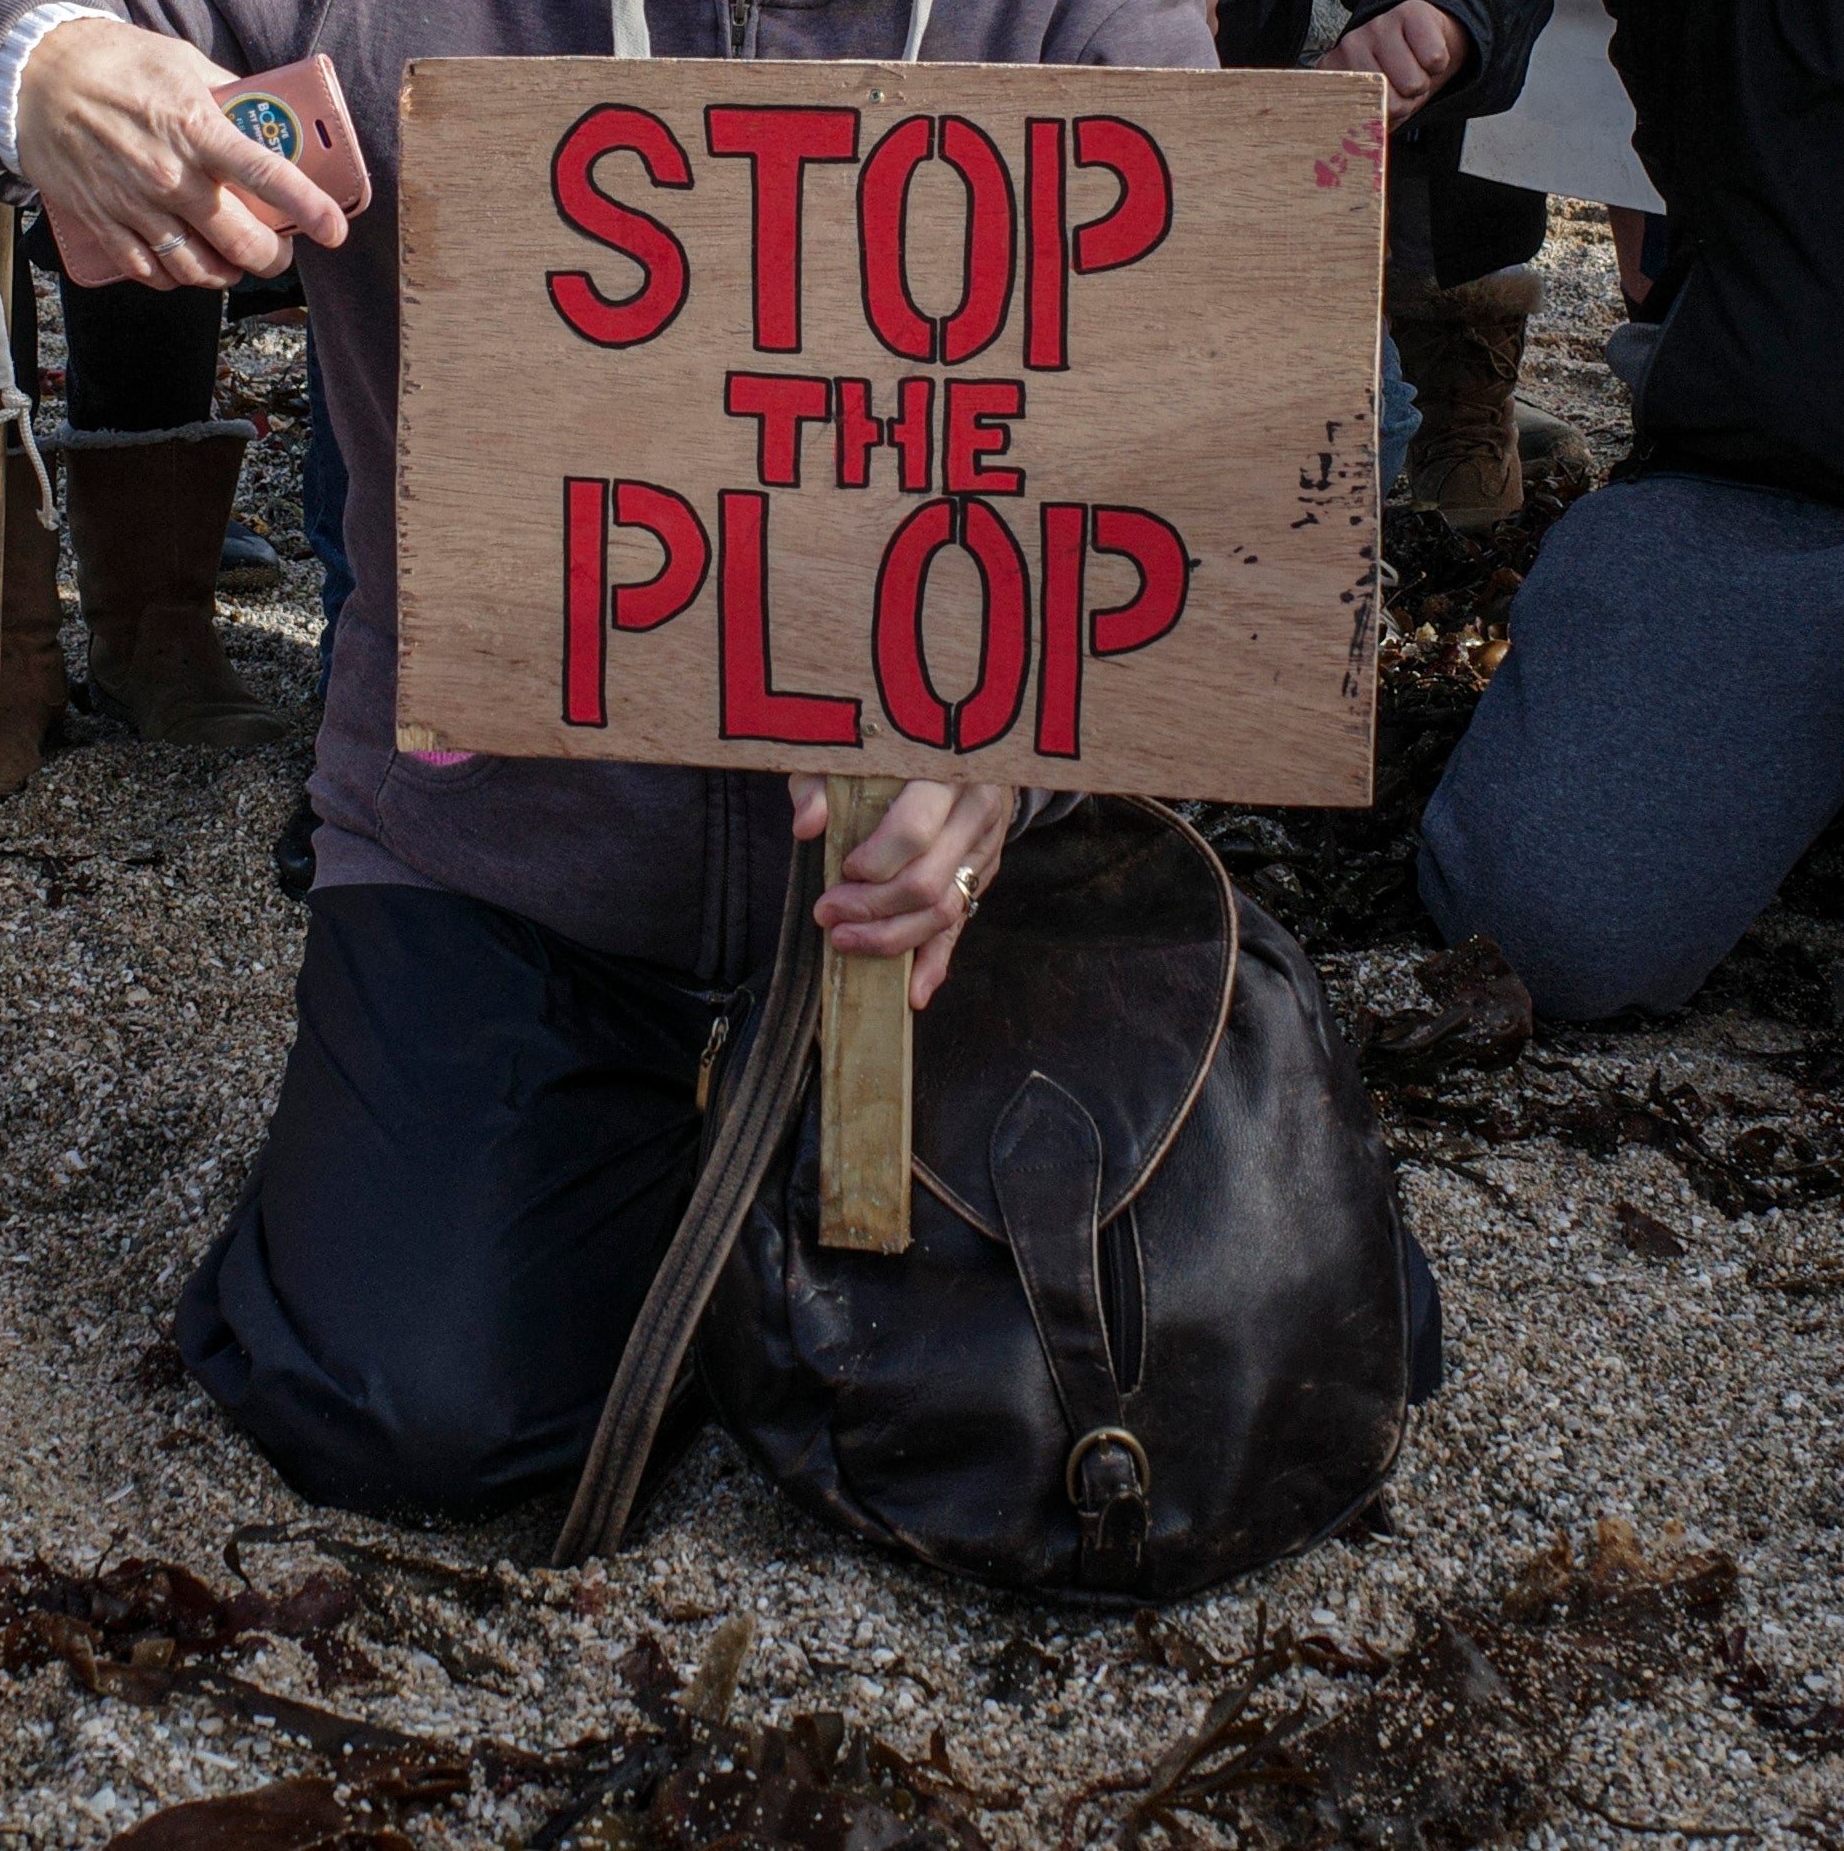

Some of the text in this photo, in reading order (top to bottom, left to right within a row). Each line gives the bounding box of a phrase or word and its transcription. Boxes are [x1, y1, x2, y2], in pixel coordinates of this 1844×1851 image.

[546, 102, 1174, 372] STOP
[724, 371, 1025, 496] THE
[561, 476, 1189, 759] PLOP
